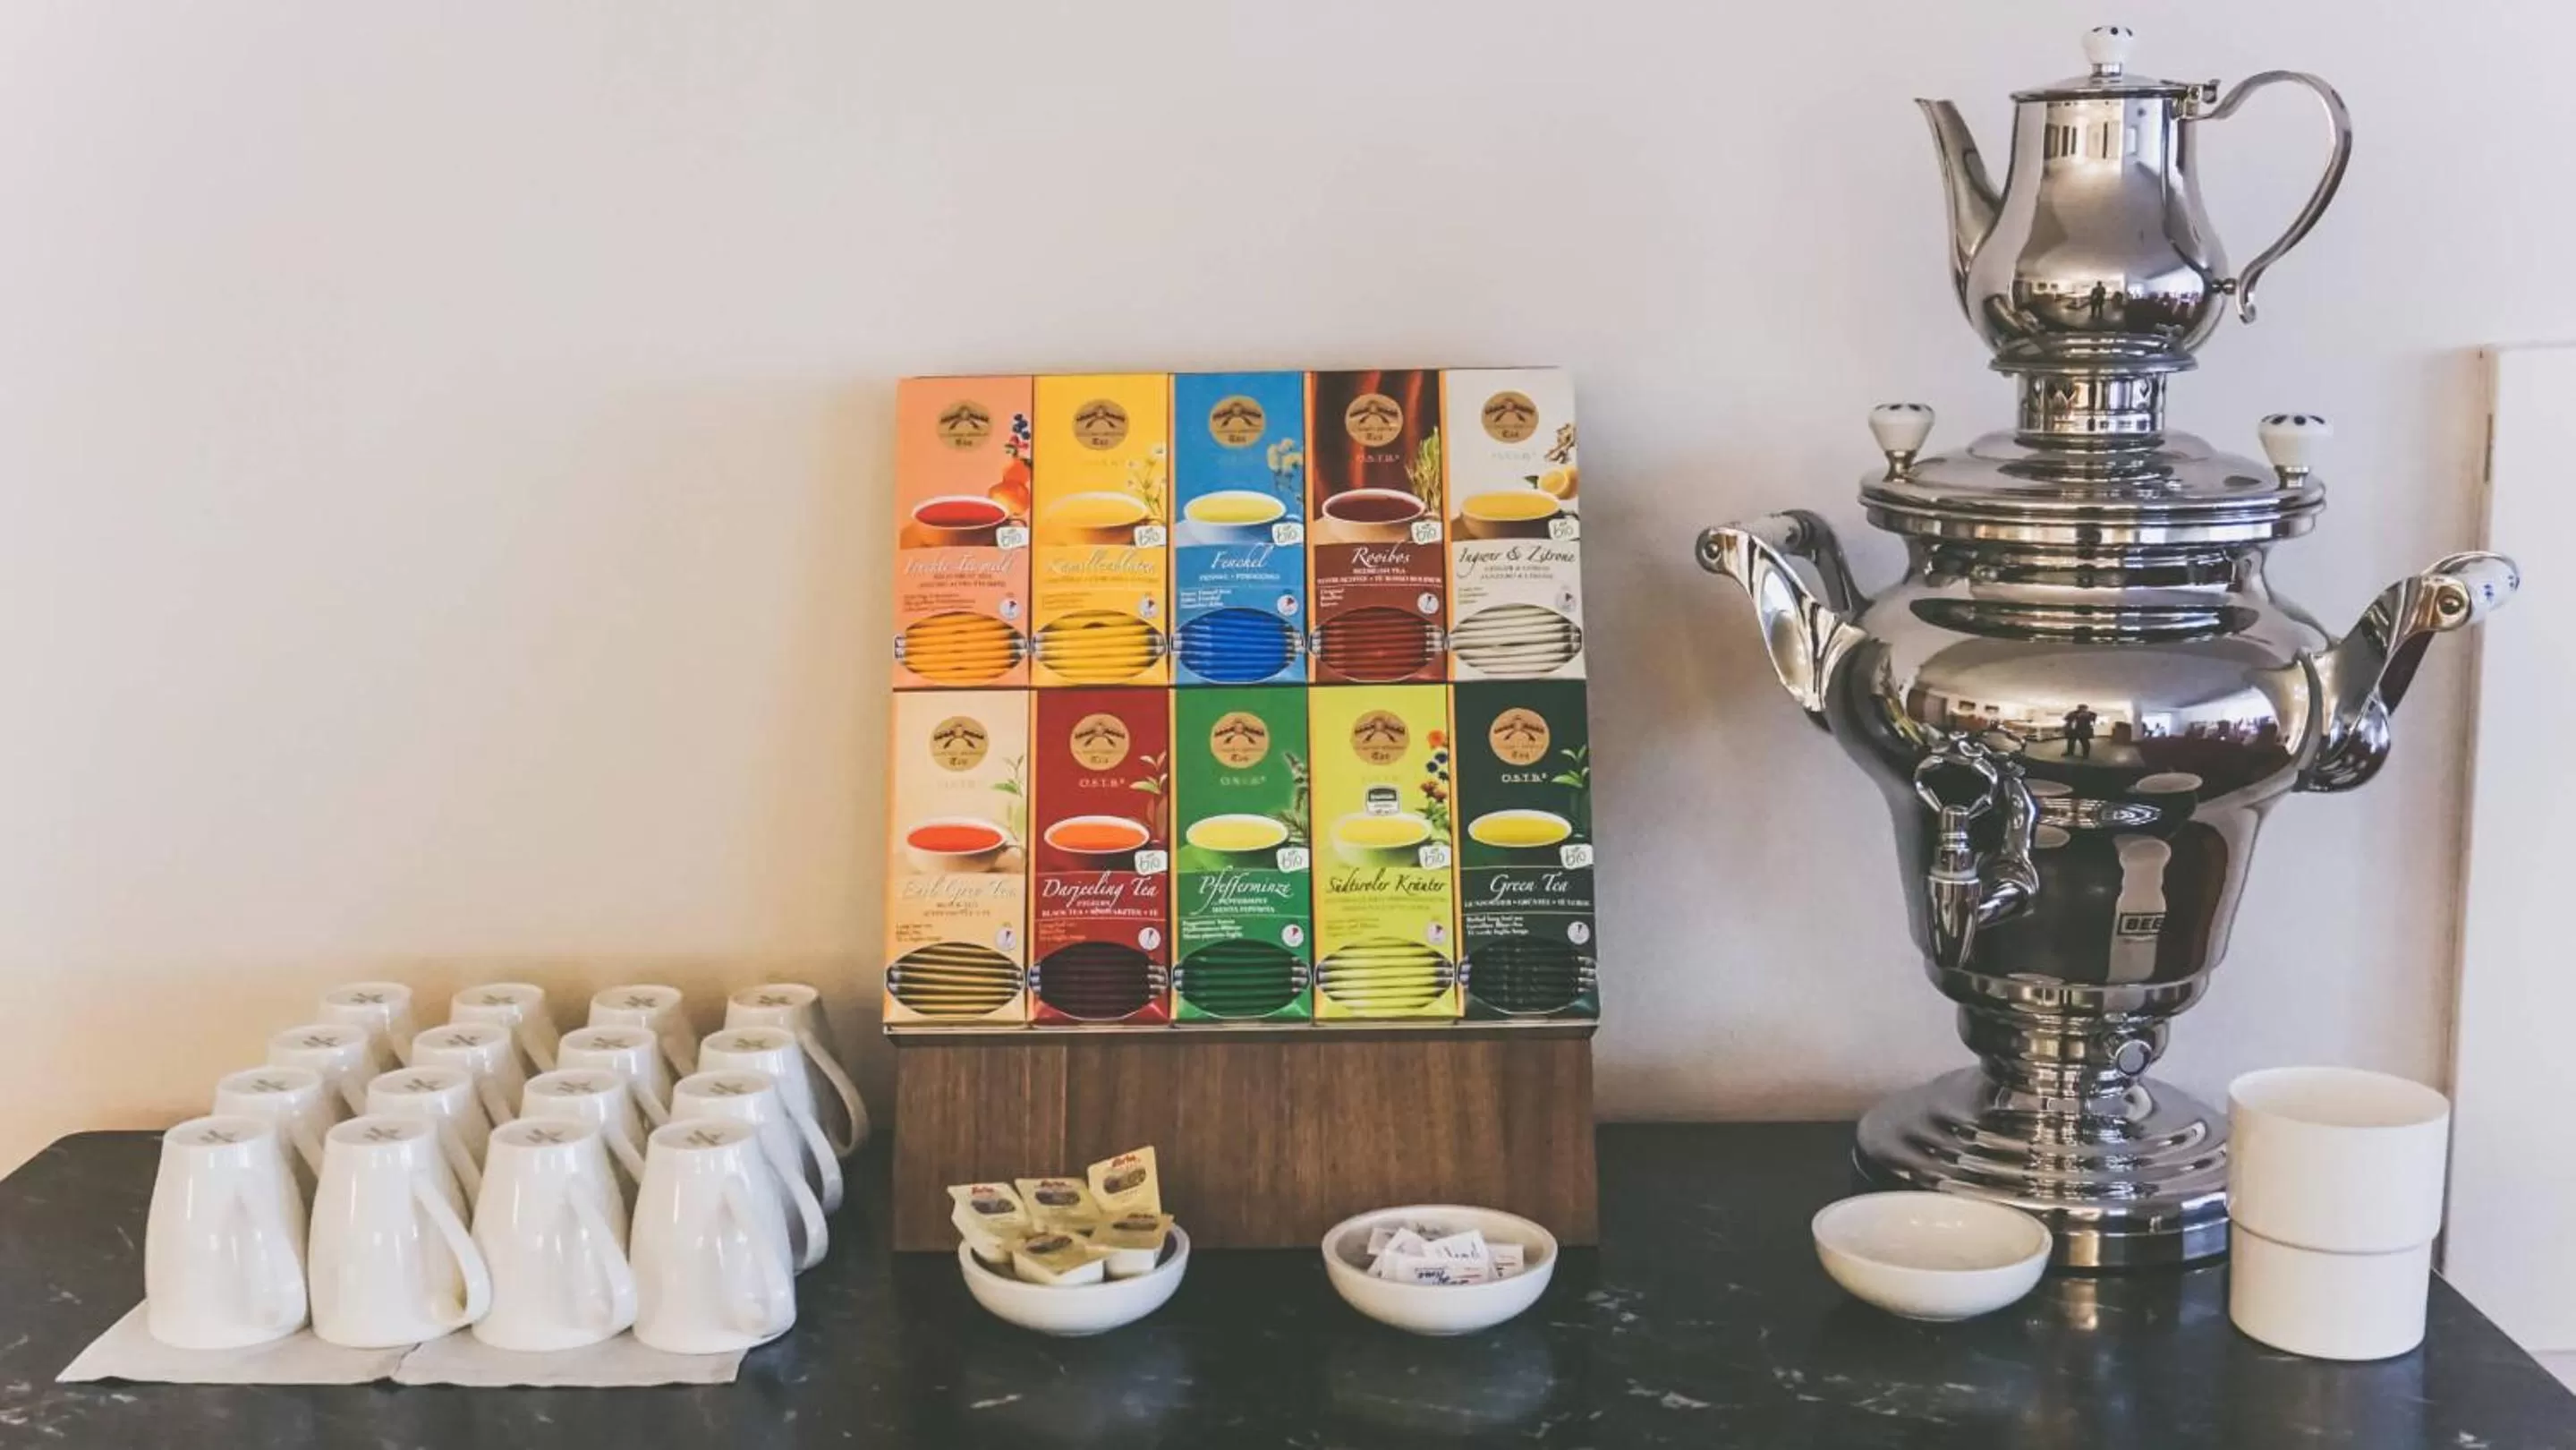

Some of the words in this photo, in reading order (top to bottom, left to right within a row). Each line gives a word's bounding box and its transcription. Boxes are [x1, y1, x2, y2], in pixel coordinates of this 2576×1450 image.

[1210, 542, 1274, 569] Fenchel
[1351, 538, 1411, 567] Rooibos
[1457, 547, 1501, 578] Ingwer
[1507, 546, 1522, 561] &
[1527, 545, 1577, 563] Zitrone
[1041, 868, 1125, 908] Darjeeling
[1131, 875, 1159, 897] Tea
[1189, 865, 1295, 916] Pfefferminze
[1326, 866, 1390, 894] Südtiroler
[1396, 874, 1449, 896] Kräuter
[1490, 874, 1535, 901] Green
[1542, 871, 1569, 892] Tea
